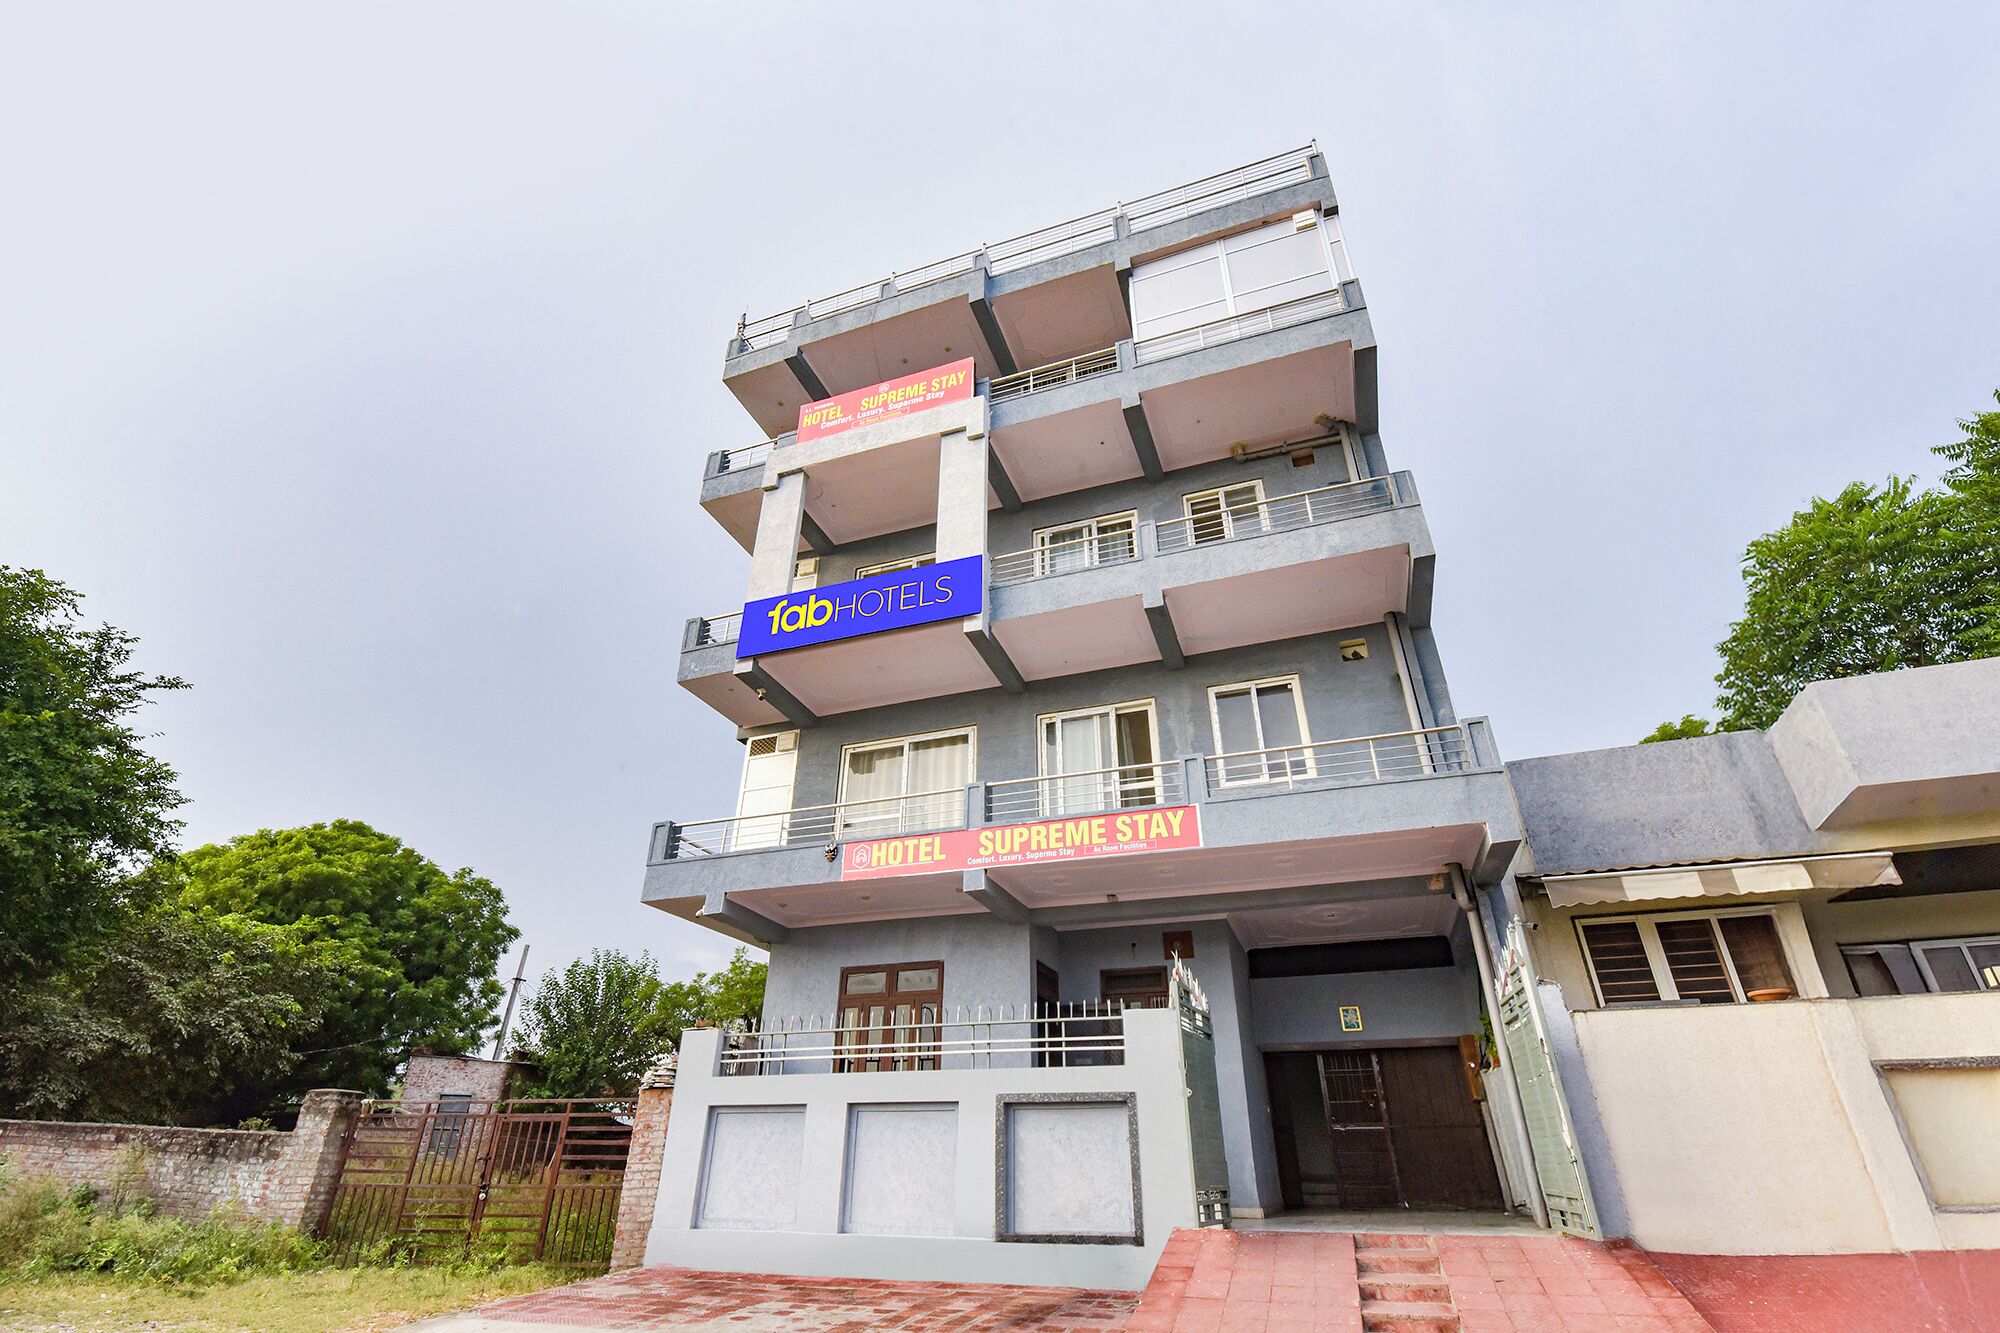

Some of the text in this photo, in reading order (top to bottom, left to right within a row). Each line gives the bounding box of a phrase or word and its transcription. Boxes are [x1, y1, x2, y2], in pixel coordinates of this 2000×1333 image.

[803, 405, 843, 428] HOTEL
[861, 381, 927, 411] SUPREME
[931, 370, 966, 392] STAY
[926, 389, 945, 401] Stay
[871, 810, 1184, 867] HOTEL SUPREME STAY
[967, 847, 1075, 865] Comfort. Luxury. Superme Stay
[1102, 844, 1119, 852] Room
